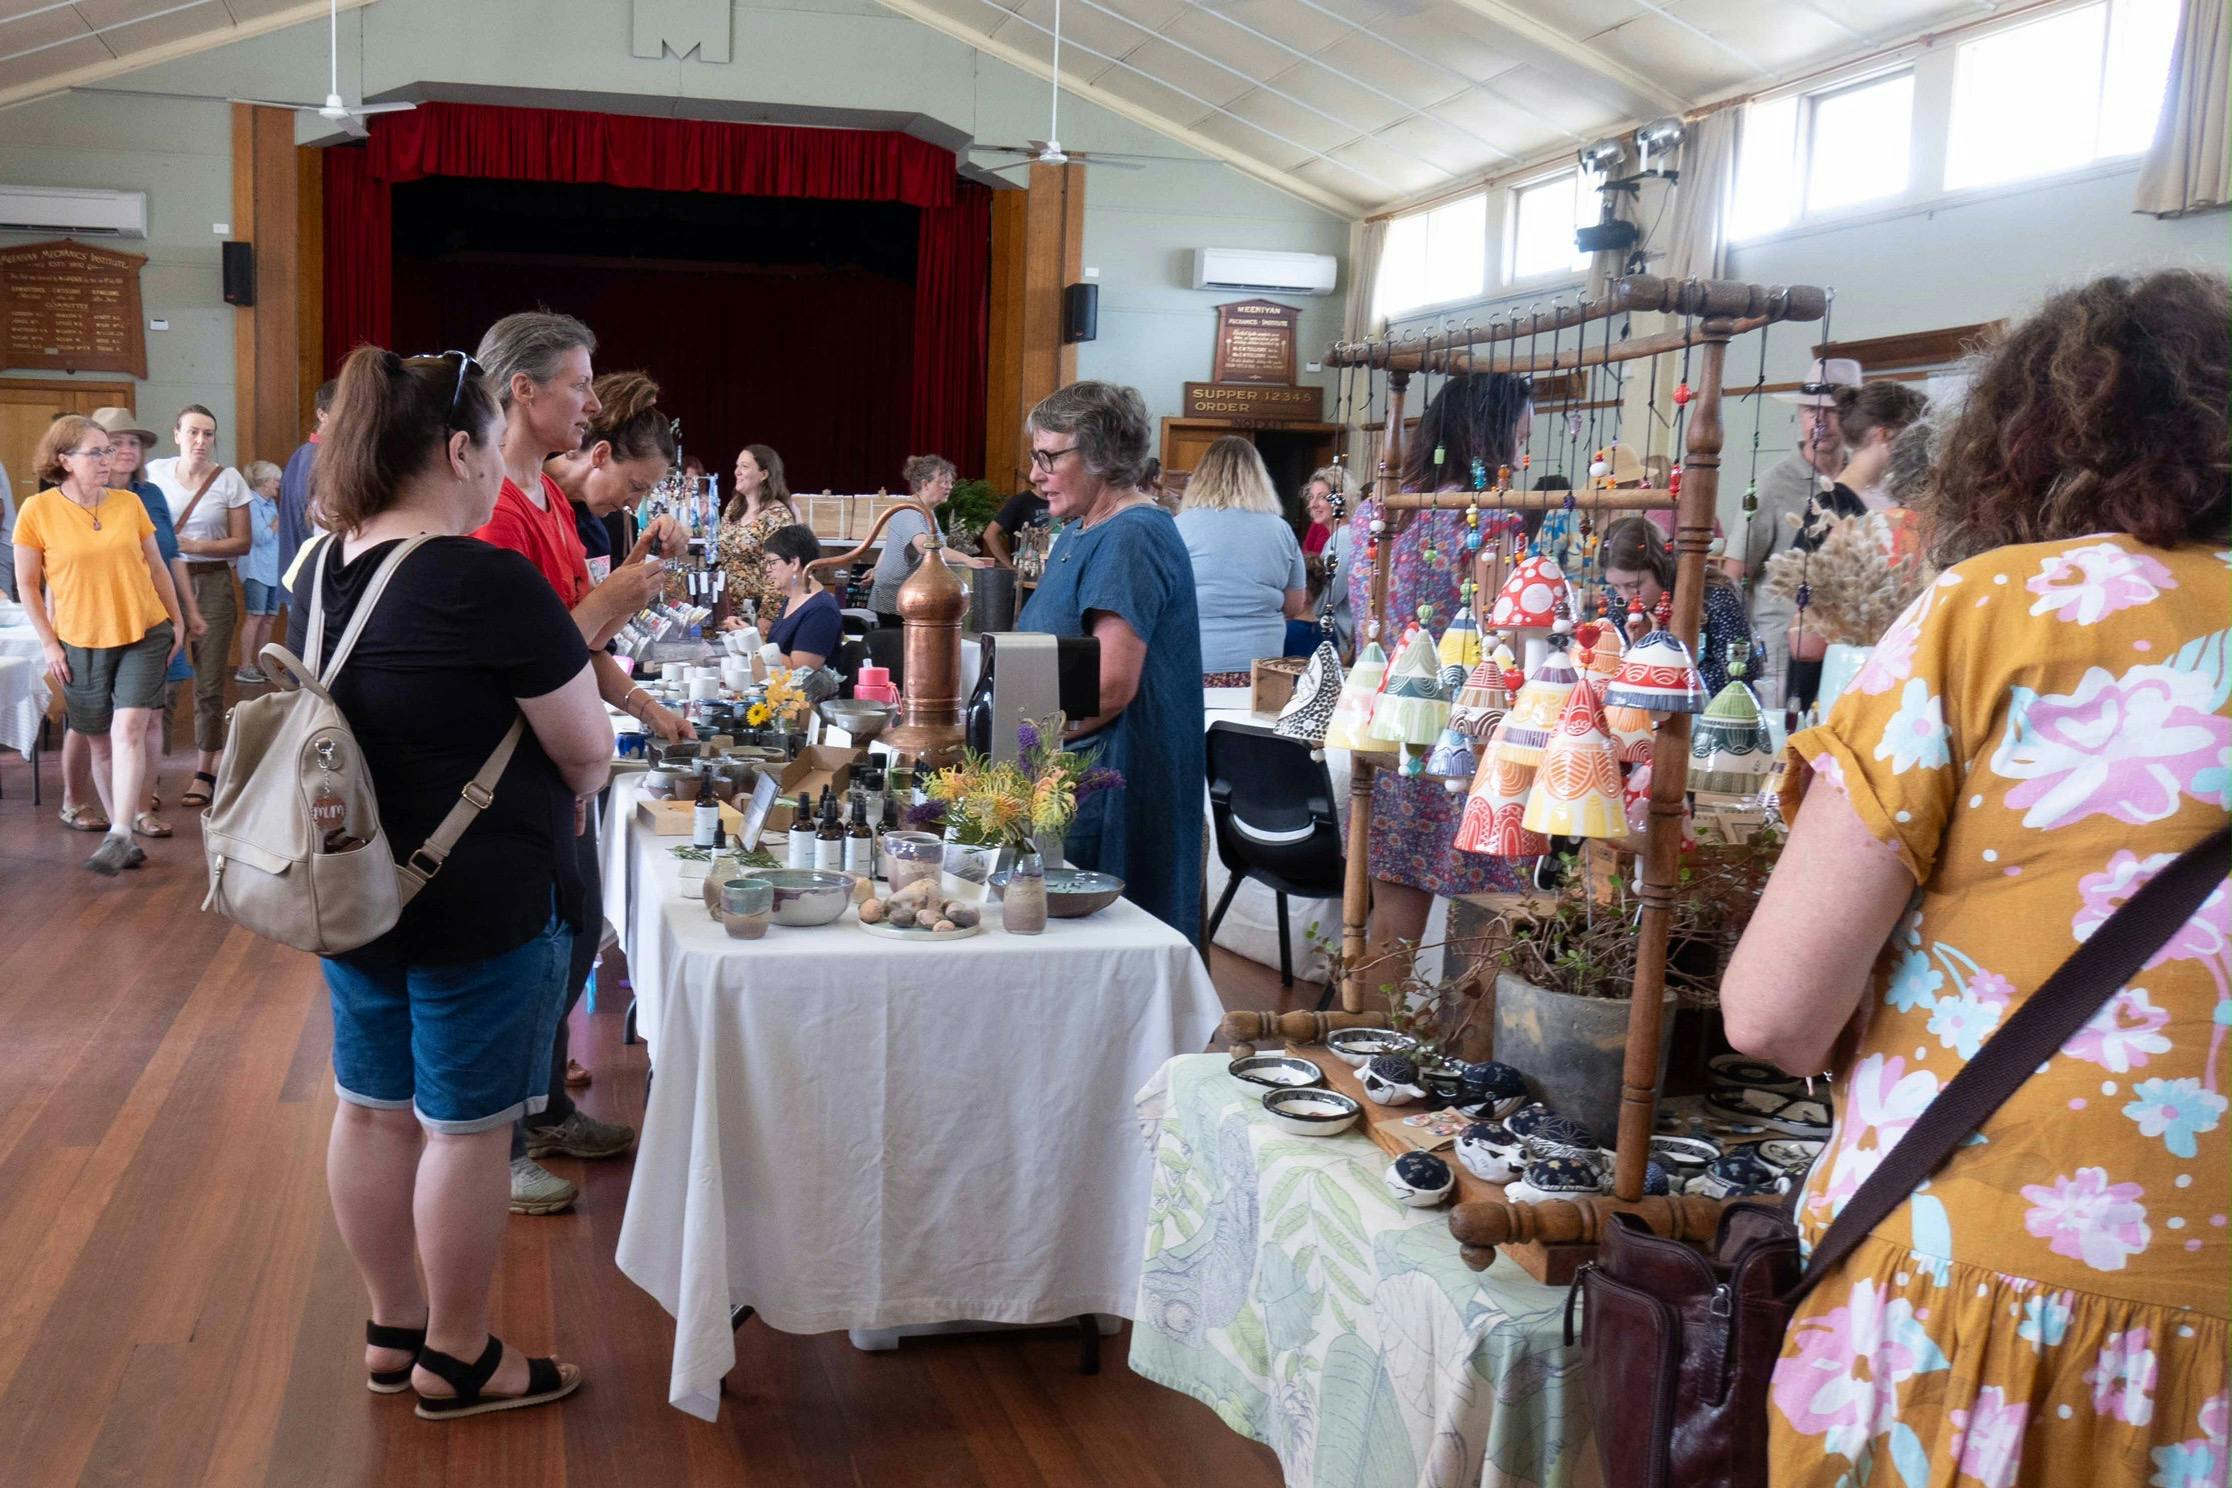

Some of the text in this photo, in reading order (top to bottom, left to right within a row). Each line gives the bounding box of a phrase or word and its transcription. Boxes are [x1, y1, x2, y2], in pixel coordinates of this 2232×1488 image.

[1237, 305, 1281, 314] MEENIYAN
[1192, 388, 1258, 401] SUPPER
[1194, 401, 1250, 413] ORDER
